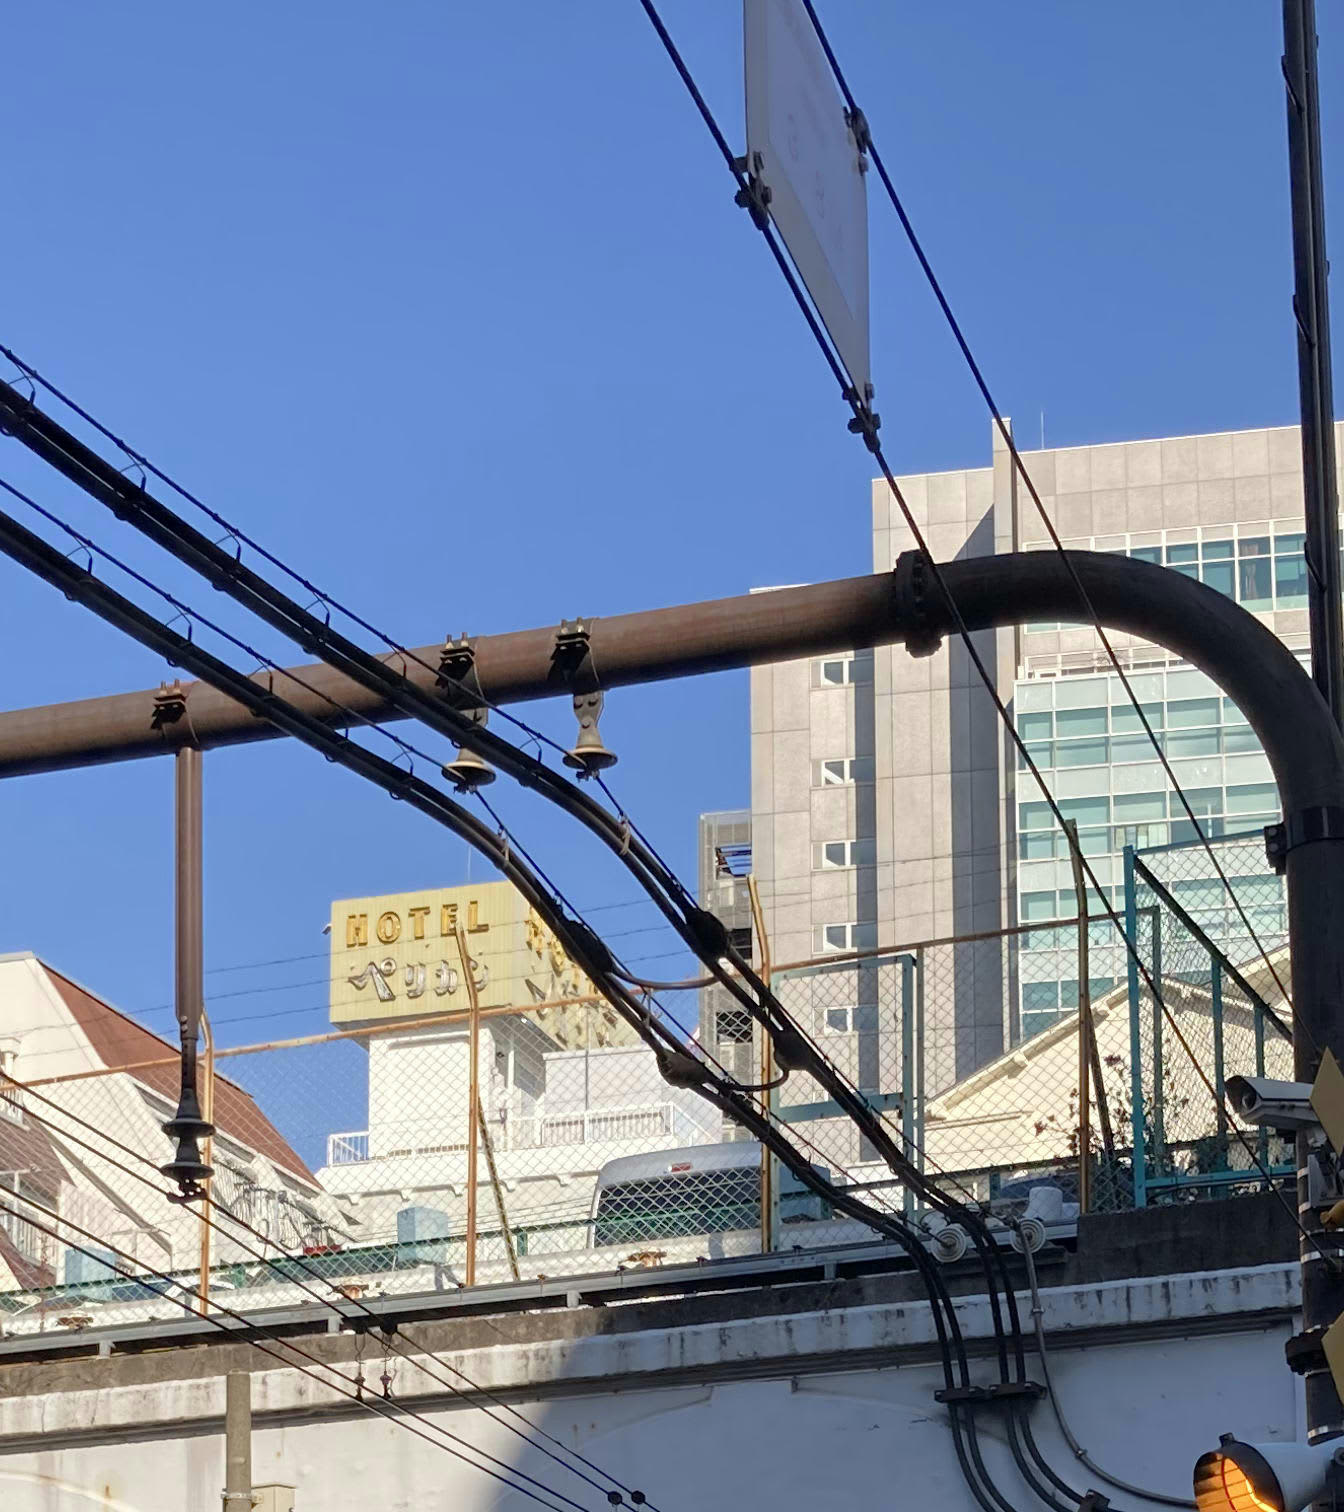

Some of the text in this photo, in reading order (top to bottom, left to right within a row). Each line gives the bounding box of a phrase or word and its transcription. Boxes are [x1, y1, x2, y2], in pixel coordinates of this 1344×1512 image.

[346, 900, 490, 948] HOTEL
[347, 956, 490, 1002] ペリカン
